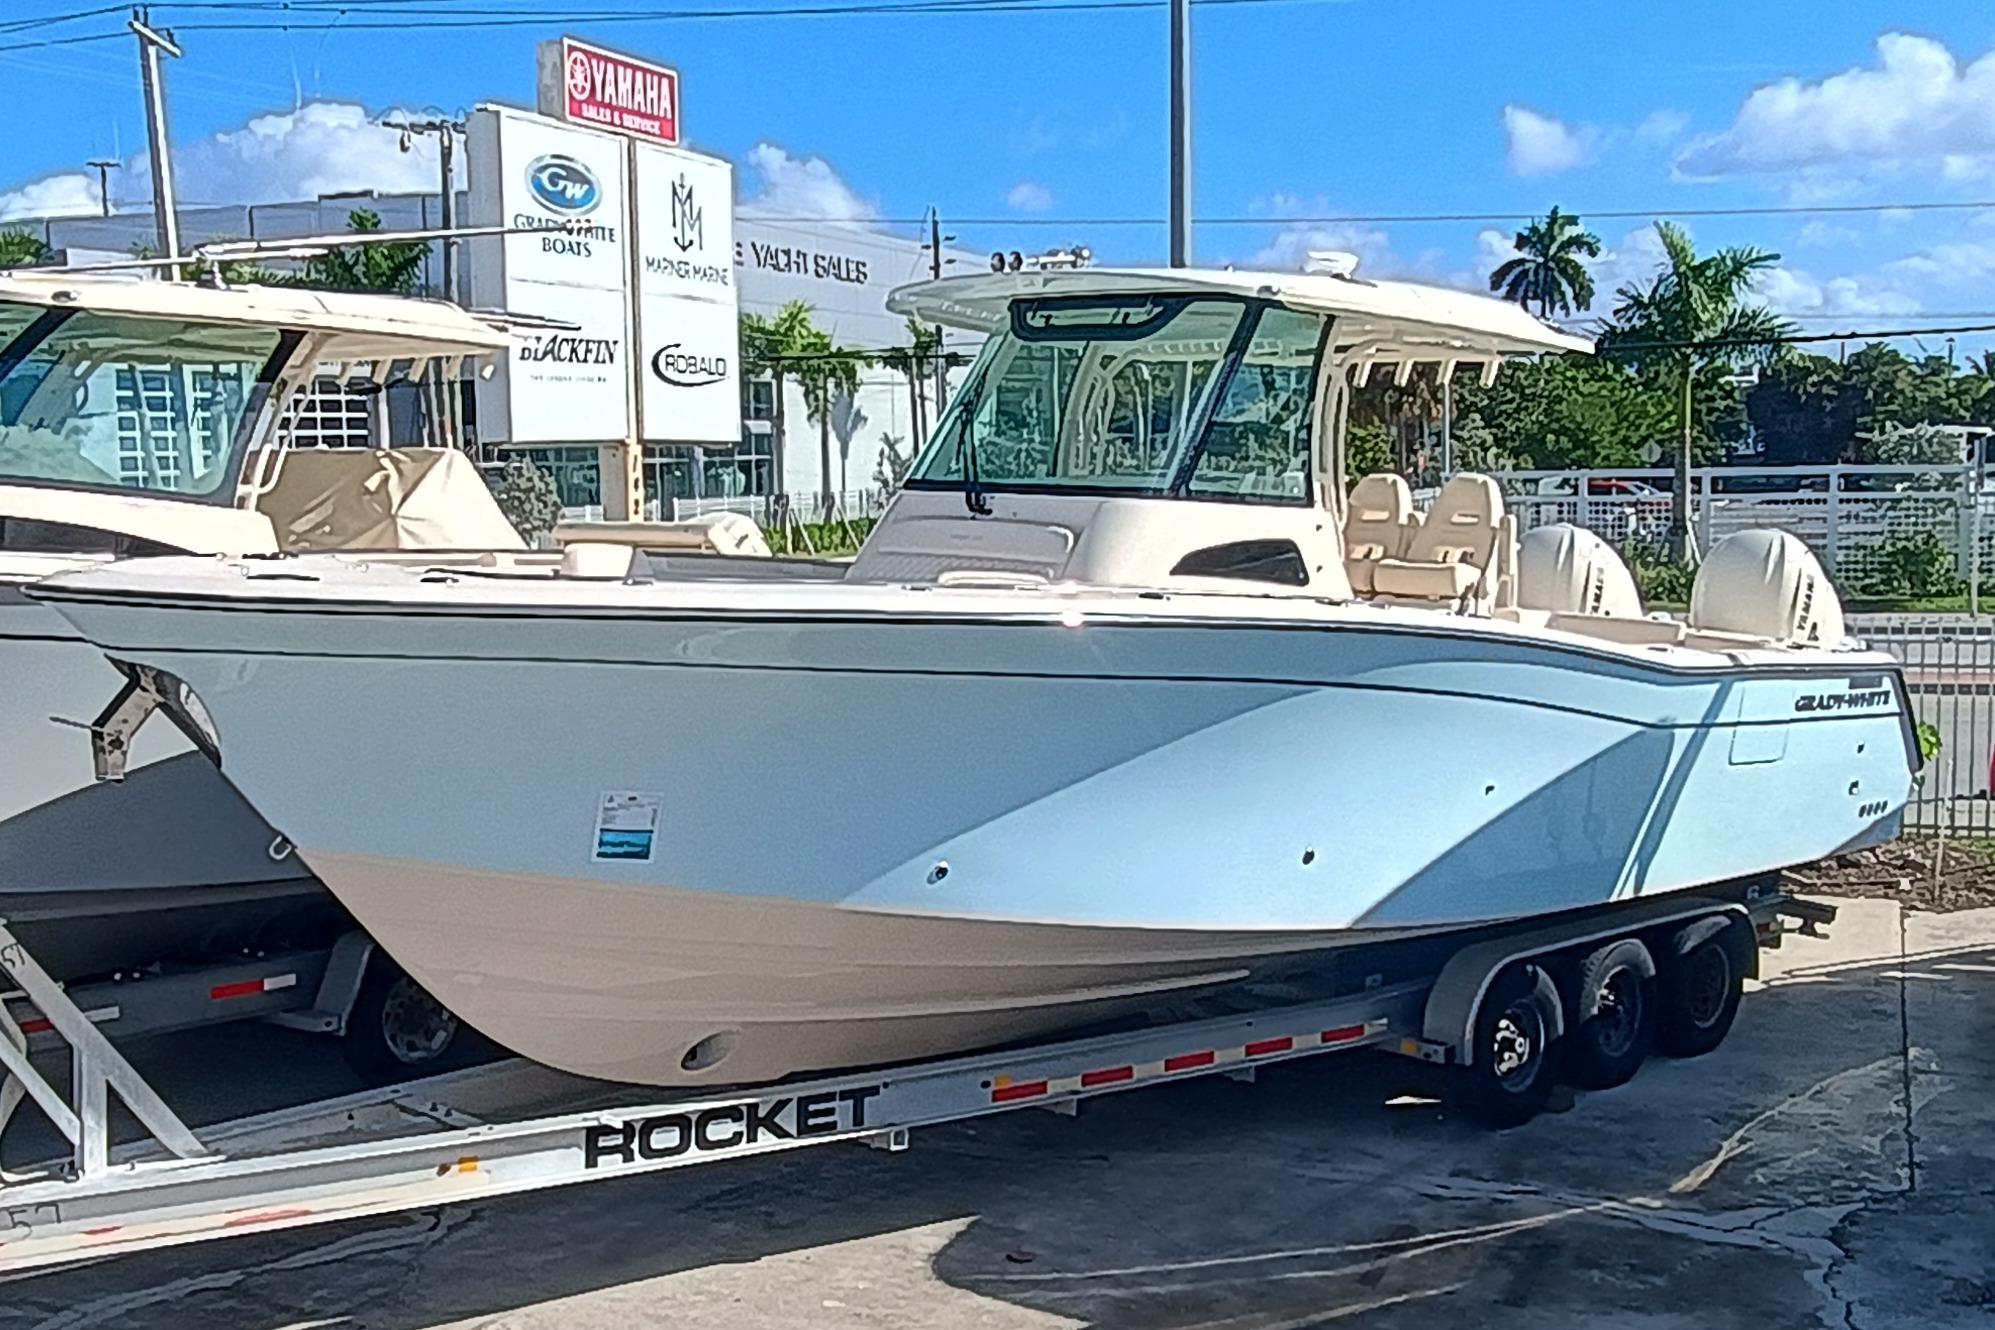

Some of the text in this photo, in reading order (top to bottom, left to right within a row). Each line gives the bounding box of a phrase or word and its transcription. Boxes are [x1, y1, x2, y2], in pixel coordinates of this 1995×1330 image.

[591, 58, 672, 119] YAMAHA
[542, 236, 592, 258] BOATS
[750, 241, 809, 275] YACHT
[814, 253, 868, 285] SALES
[664, 353, 727, 377] ROBALO
[1796, 573, 1815, 631] YAMAHA
[584, 1085, 881, 1169] ROCKET
[8, 1202, 61, 1240] 57
